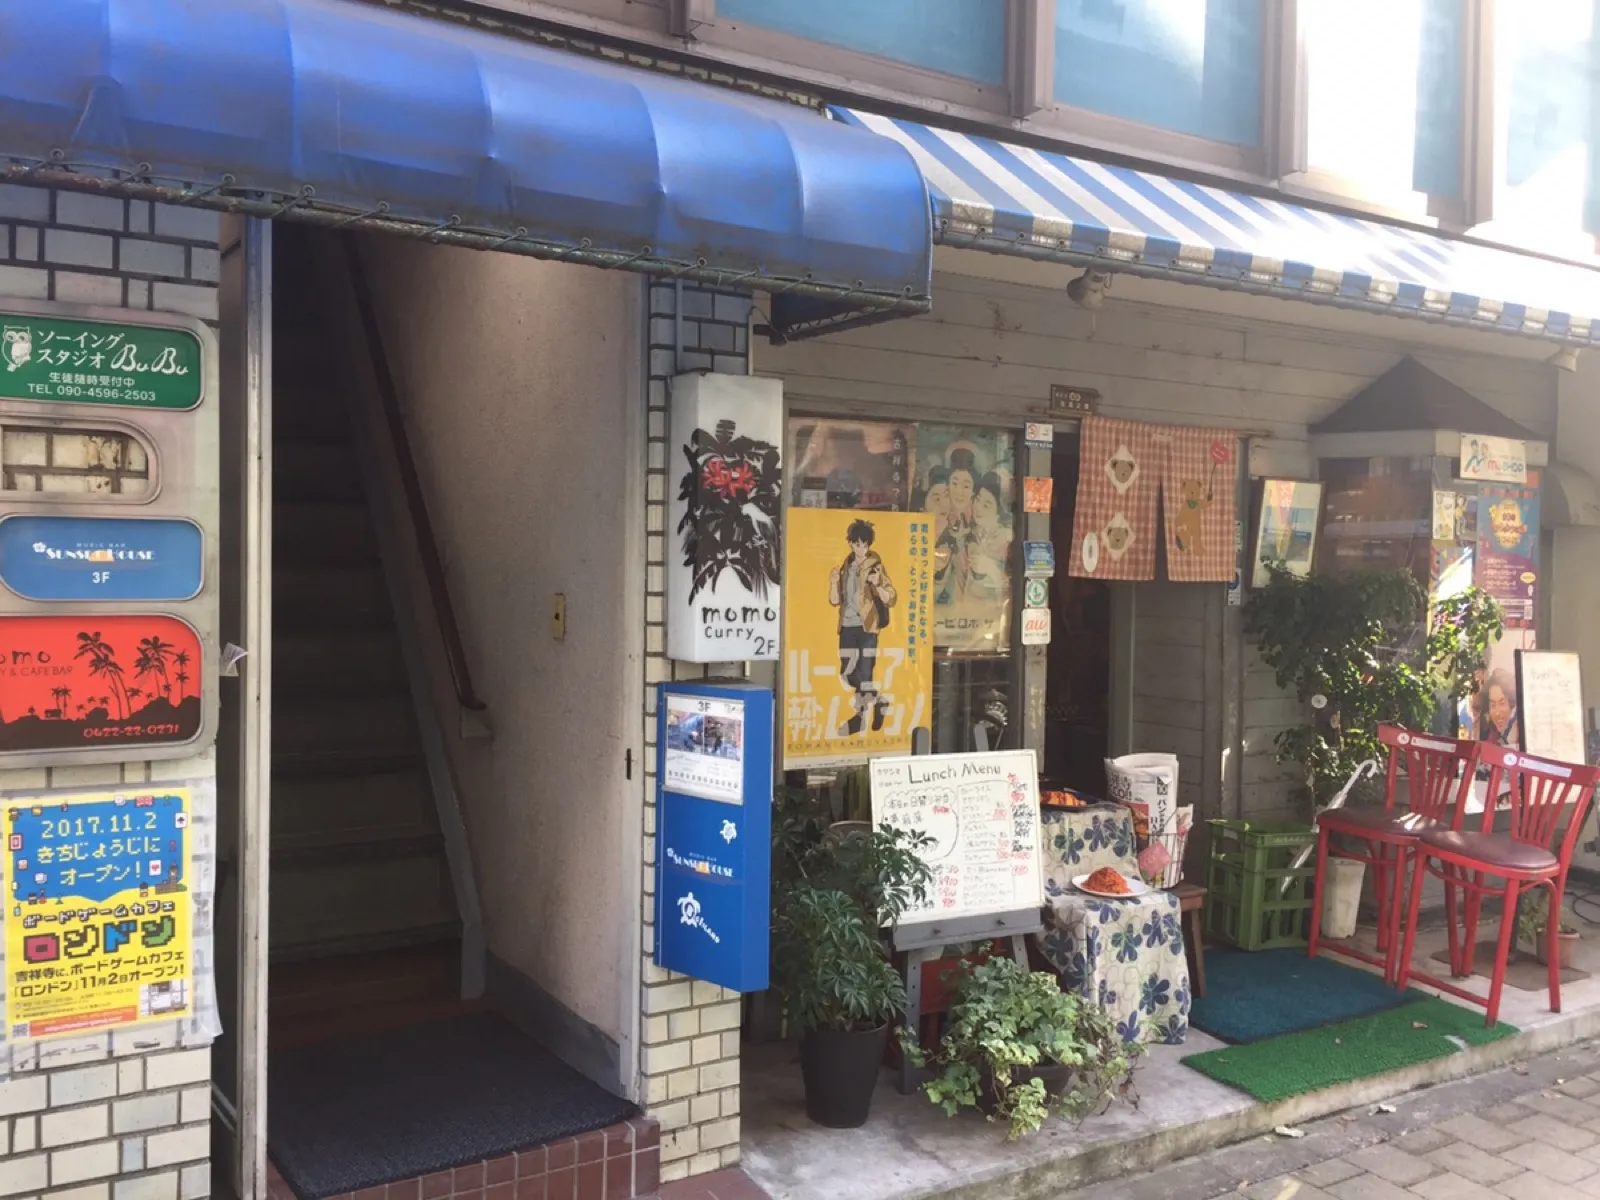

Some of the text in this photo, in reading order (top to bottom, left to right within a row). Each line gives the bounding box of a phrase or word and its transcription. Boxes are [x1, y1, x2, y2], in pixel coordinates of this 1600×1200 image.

[37, 330, 125, 350] ソーイング
[36, 349, 106, 369] スタジオ
[28, 383, 156, 401] TEL 090-4596-2503
[92, 571, 110, 584] 3F
[702, 606, 776, 624] momo
[1025, 619, 1047, 631] au
[753, 636, 776, 656] 2F
[698, 700, 711, 713] 3F
[908, 764, 957, 785] Lunch
[961, 763, 1001, 778] Menu
[37, 836, 161, 864] きちじょうじに
[60, 862, 141, 886] オープン!
[23, 899, 176, 928] ボードゲームカフェ
[23, 915, 176, 964] ロンドン
